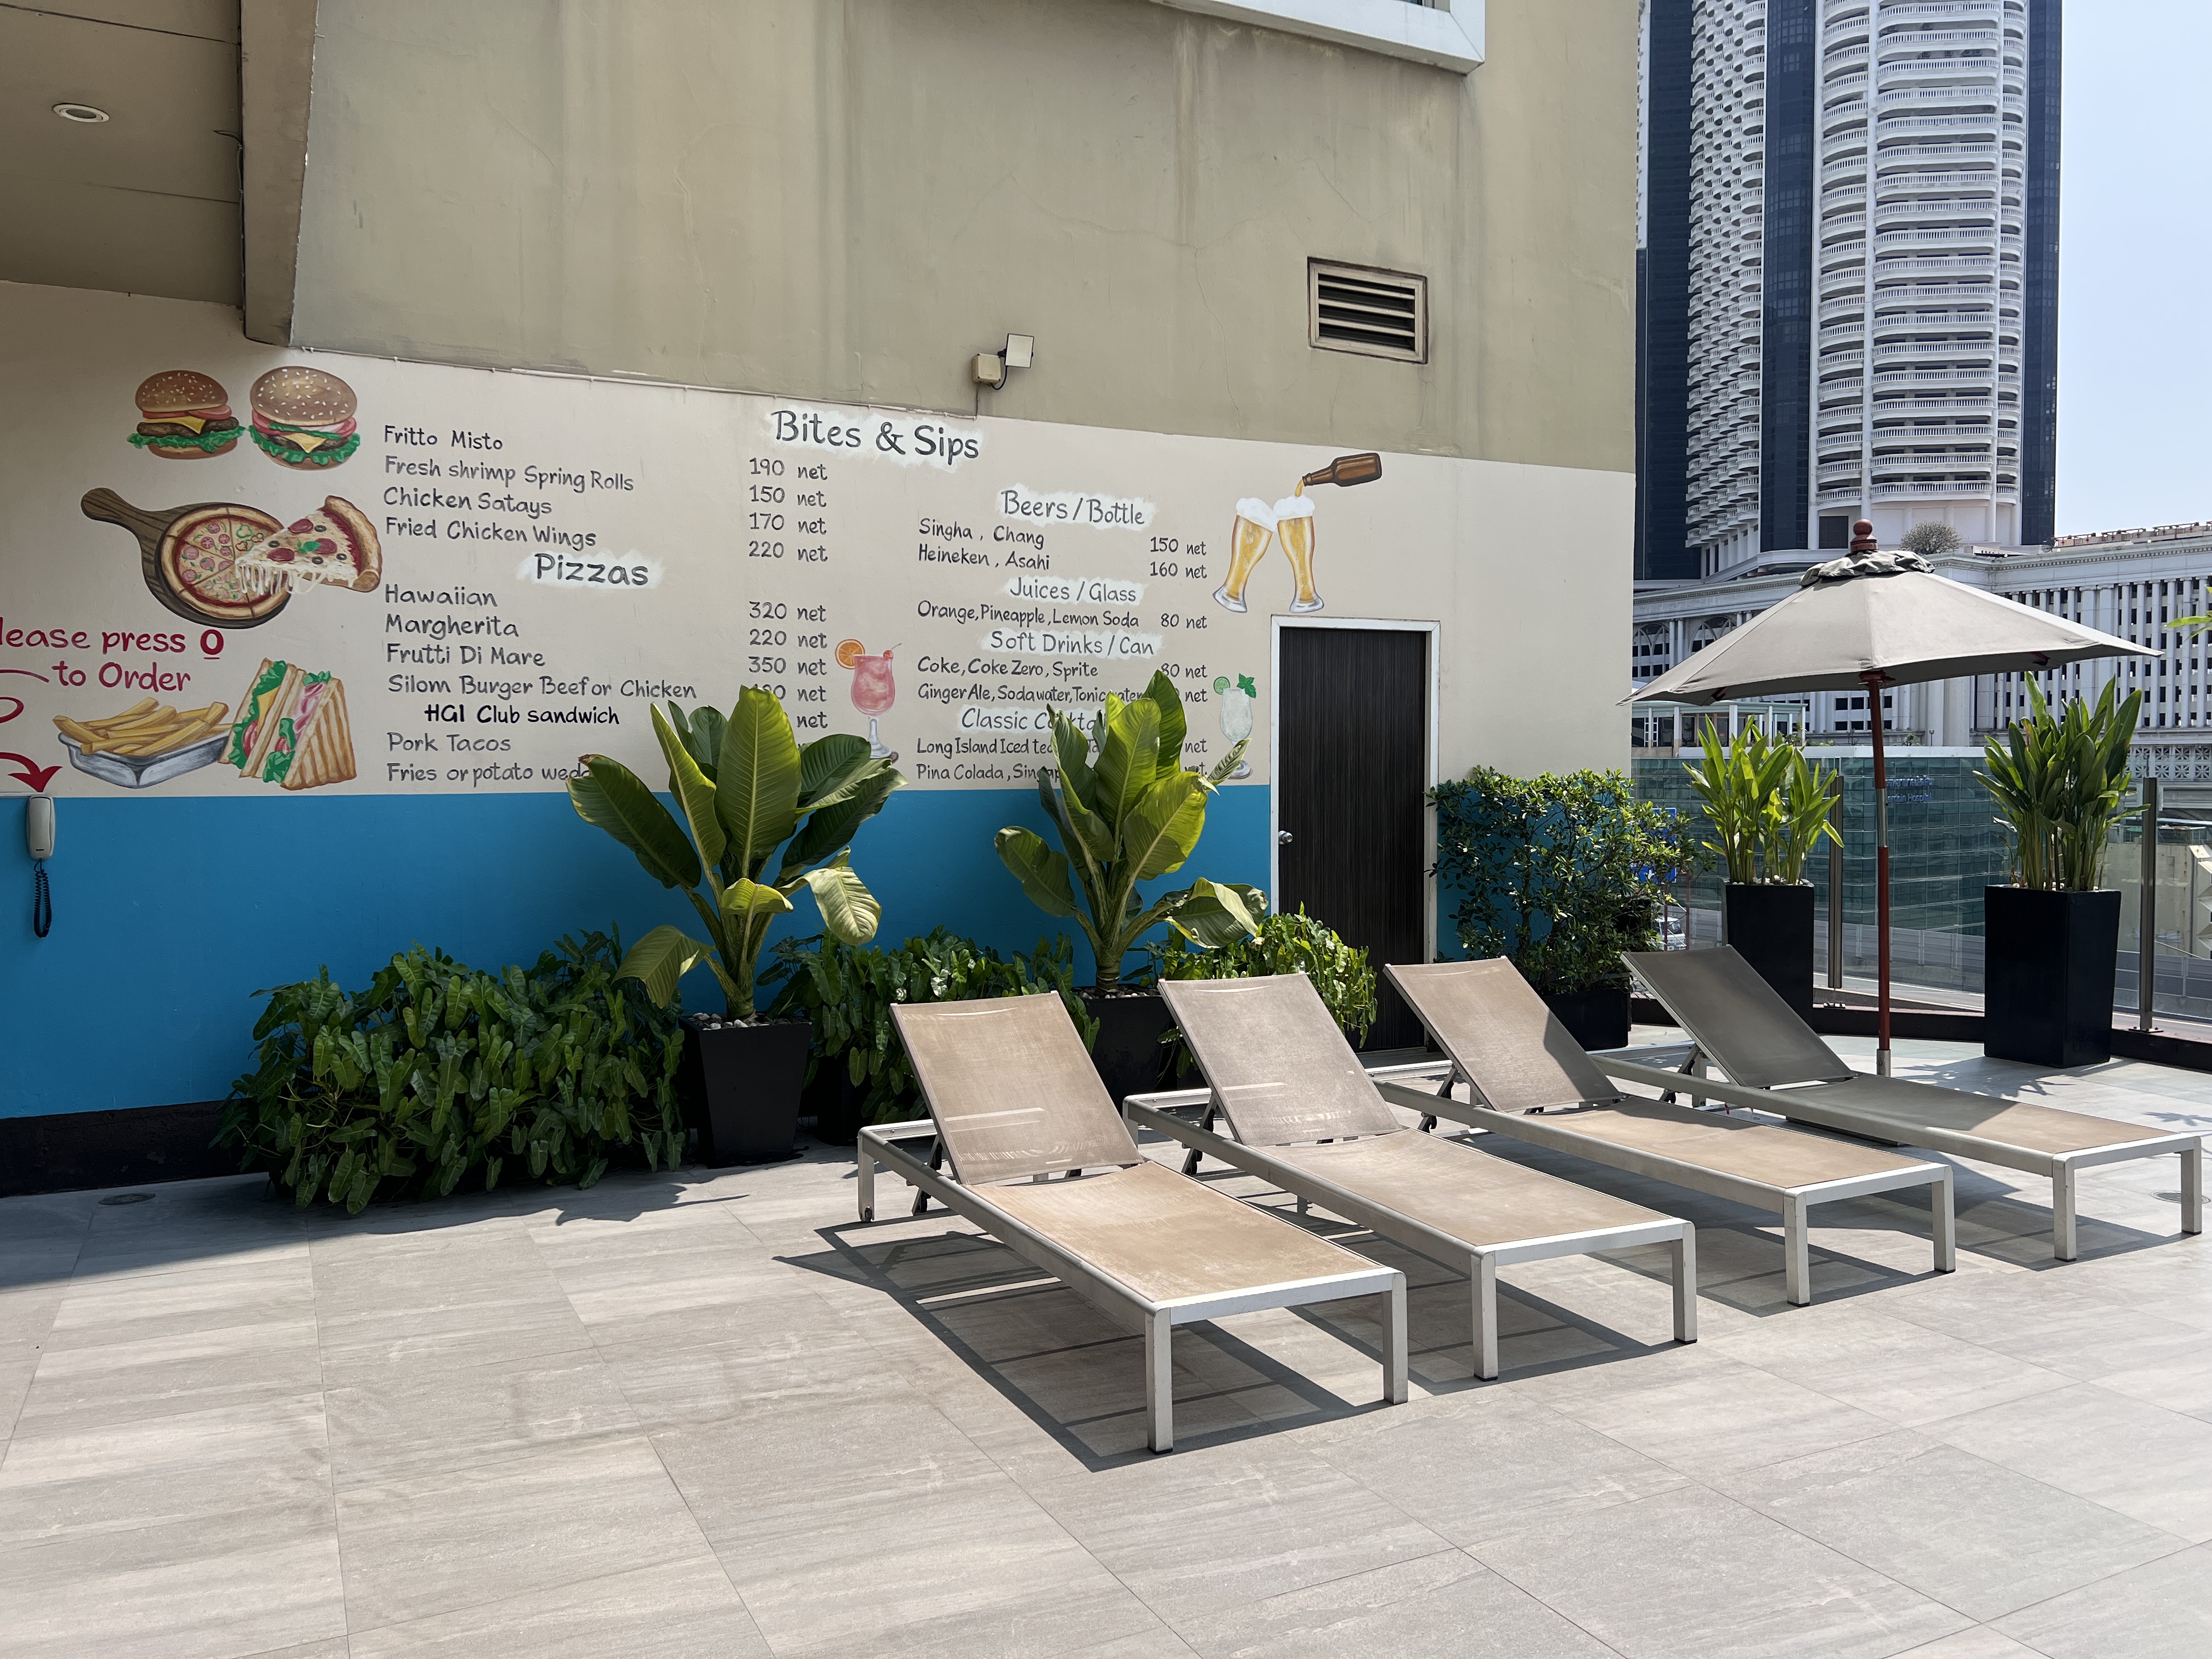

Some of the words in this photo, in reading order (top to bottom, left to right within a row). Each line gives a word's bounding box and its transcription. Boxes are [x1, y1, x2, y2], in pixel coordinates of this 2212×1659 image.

[385, 425, 438, 446] Fritto
[451, 430, 503, 450] Misto
[770, 410, 861, 448] Bites
[876, 421, 906, 455] &
[914, 425, 979, 466] Sips
[385, 455, 442, 477] Fresh
[448, 460, 516, 488] shrimp
[524, 465, 585, 494] Spring
[590, 470, 634, 491] Rolls
[749, 457, 785, 476] 190
[798, 464, 828, 481] net
[383, 486, 472, 510] Chicken
[477, 492, 552, 520] Satays
[749, 484, 785, 504] 150
[797, 490, 827, 507] net
[1001, 490, 1068, 520] Beers
[1072, 497, 1084, 521] /
[1086, 499, 1145, 524] Bottle
[386, 516, 437, 539] Fried
[447, 520, 528, 543] Chicken
[532, 525, 597, 552] Wings
[749, 512, 785, 531] 170
[798, 517, 827, 535] net
[993, 525, 1044, 550] Chang
[1150, 536, 1179, 553] 150
[1187, 541, 1207, 556] net
[749, 540, 785, 558] 220
[797, 545, 828, 562] net
[1005, 550, 1049, 571] Asahi
[534, 553, 648, 586] Pizzas
[1150, 561, 1178, 577] 160
[1185, 565, 1207, 579] net
[385, 583, 498, 607] Hawaiian
[1010, 577, 1070, 600] Juices
[1076, 581, 1085, 601] /
[1089, 583, 1136, 602] Glass
[749, 601, 787, 619] 320
[797, 605, 827, 622] net
[1053, 608, 1099, 626] Lemon
[1103, 610, 1139, 628] Soda
[1161, 613, 1180, 628] 80
[1186, 615, 1207, 629] net
[0, 617, 91, 648] lease
[101, 631, 186, 654] press
[385, 613, 519, 640] Margherita
[749, 628, 787, 646] 220
[797, 633, 828, 649] net
[991, 630, 1036, 651] Soft
[1042, 634, 1103, 654] Drinks
[1107, 634, 1115, 656] /
[1119, 636, 1154, 655] Can
[387, 643, 450, 664] Frutti
[459, 645, 482, 665] Di
[490, 646, 546, 667] Mare
[748, 656, 787, 674] 350
[797, 658, 827, 676] net
[52, 661, 86, 686] to
[99, 662, 191, 692] Order
[967, 658, 1008, 675] Coke
[1052, 661, 1098, 682] Sprite
[1161, 663, 1180, 678] 80
[1185, 664, 1208, 679] net
[388, 674, 452, 693] Silom
[458, 675, 533, 701] Burger
[620, 679, 697, 699] Chicken
[797, 685, 827, 702] net
[1115, 687, 1143, 702] ater
[1185, 689, 1208, 703] net
[424, 703, 465, 723] HGI
[477, 704, 520, 724] Club
[527, 706, 620, 725] sandwich
[796, 711, 828, 729] net
[962, 707, 1028, 730] Classic
[386, 732, 438, 752] Pork
[446, 733, 511, 752] Tacos
[917, 737, 953, 760] Long
[955, 737, 997, 755] Island
[1000, 738, 1029, 754] Iced
[1185, 738, 1208, 753] net
[386, 763, 437, 782] Fries
[446, 769, 469, 782] or
[472, 762, 533, 788] potato
[916, 763, 951, 780] Pina
